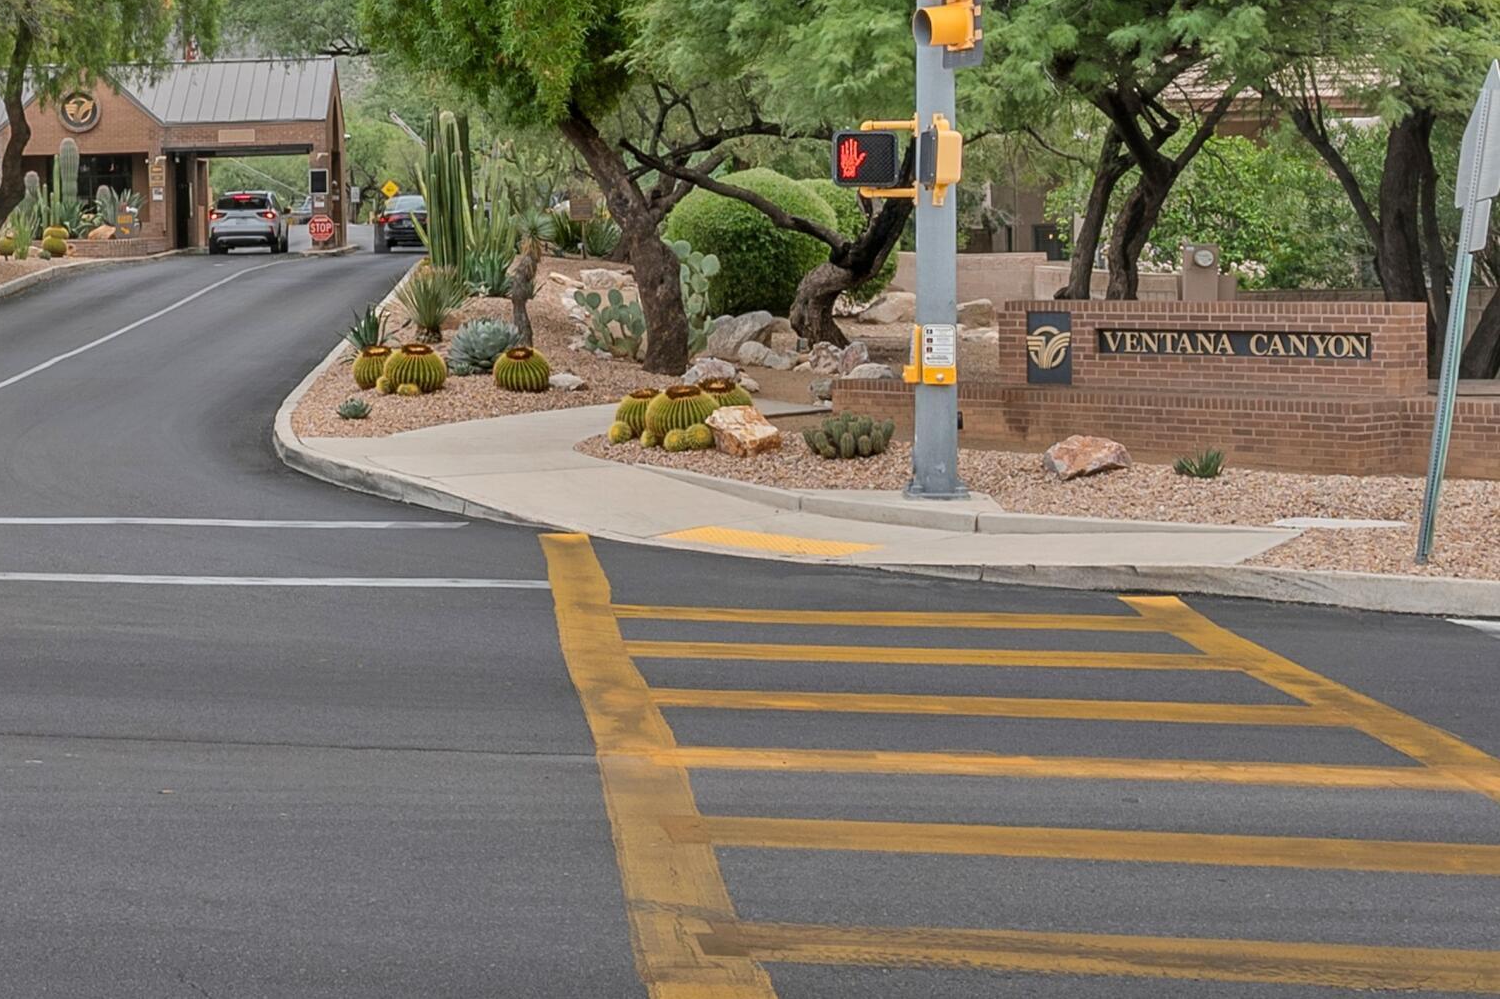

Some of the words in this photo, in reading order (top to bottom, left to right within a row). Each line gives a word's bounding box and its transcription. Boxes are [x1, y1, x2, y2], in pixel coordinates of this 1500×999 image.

[310, 222, 332, 233] STOP
[1103, 331, 1235, 355] VENTANA
[1250, 333, 1369, 358] CANYON
